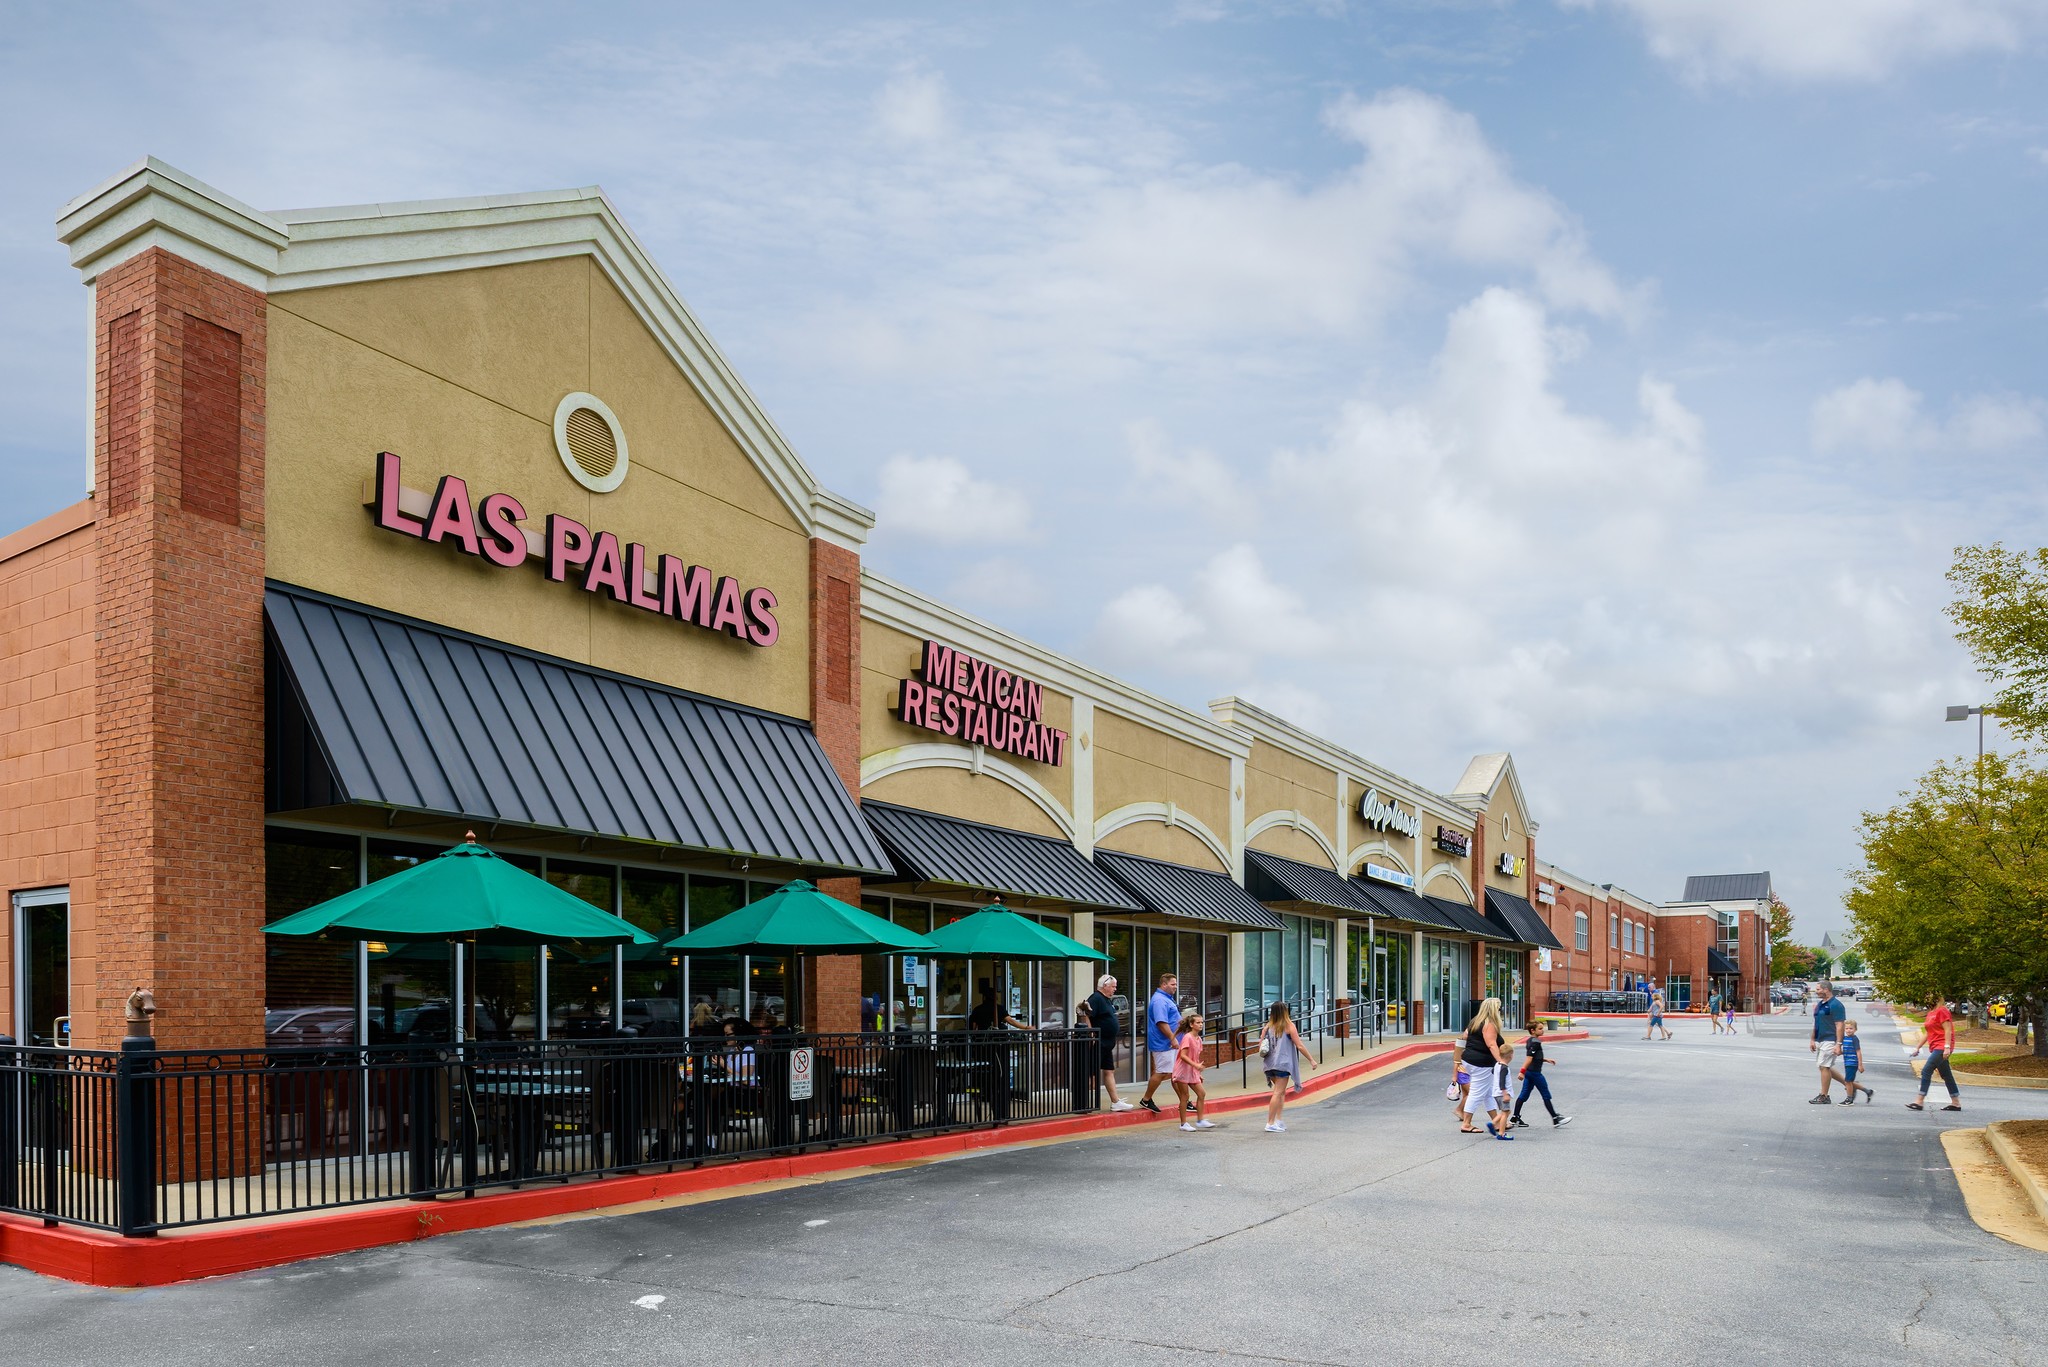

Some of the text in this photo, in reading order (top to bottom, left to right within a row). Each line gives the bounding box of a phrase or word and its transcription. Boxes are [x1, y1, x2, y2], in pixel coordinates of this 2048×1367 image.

[376, 451, 779, 647] LAS PALMAS
[923, 640, 1043, 722] MEXICAN
[899, 679, 1068, 767] RESTAURANT
[1502, 853, 1525, 878] SUBWAY
[801, 1073, 810, 1081] LANE
